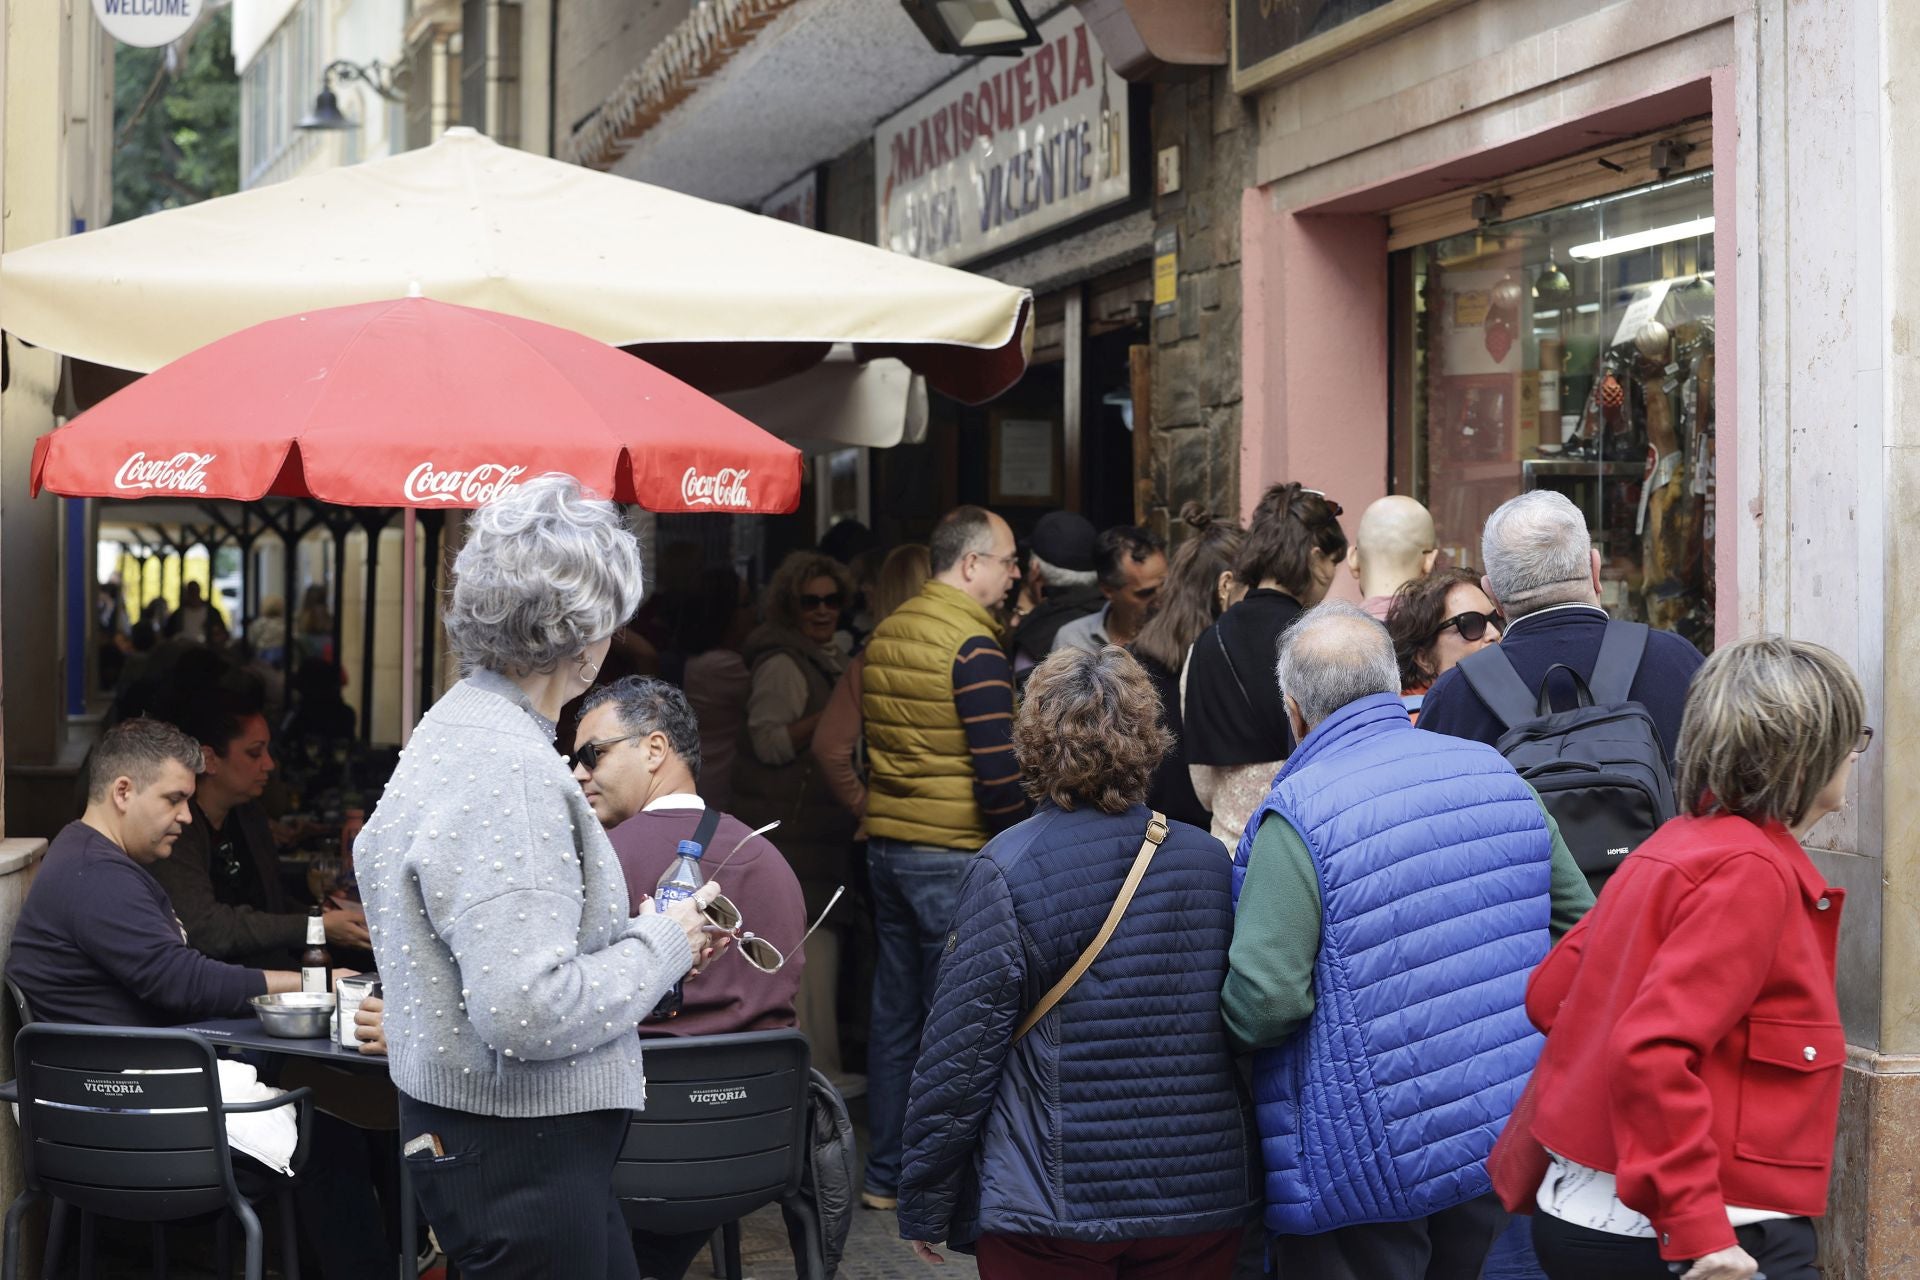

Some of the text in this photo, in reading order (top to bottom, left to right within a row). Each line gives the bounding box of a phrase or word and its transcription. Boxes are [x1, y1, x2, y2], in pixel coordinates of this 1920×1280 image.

[105, 0, 190, 16] WELCOME
[975, 120, 1092, 233] VICENTE
[84, 1083, 144, 1093] VICTORIA
[689, 1090, 747, 1103] VICTORIA
